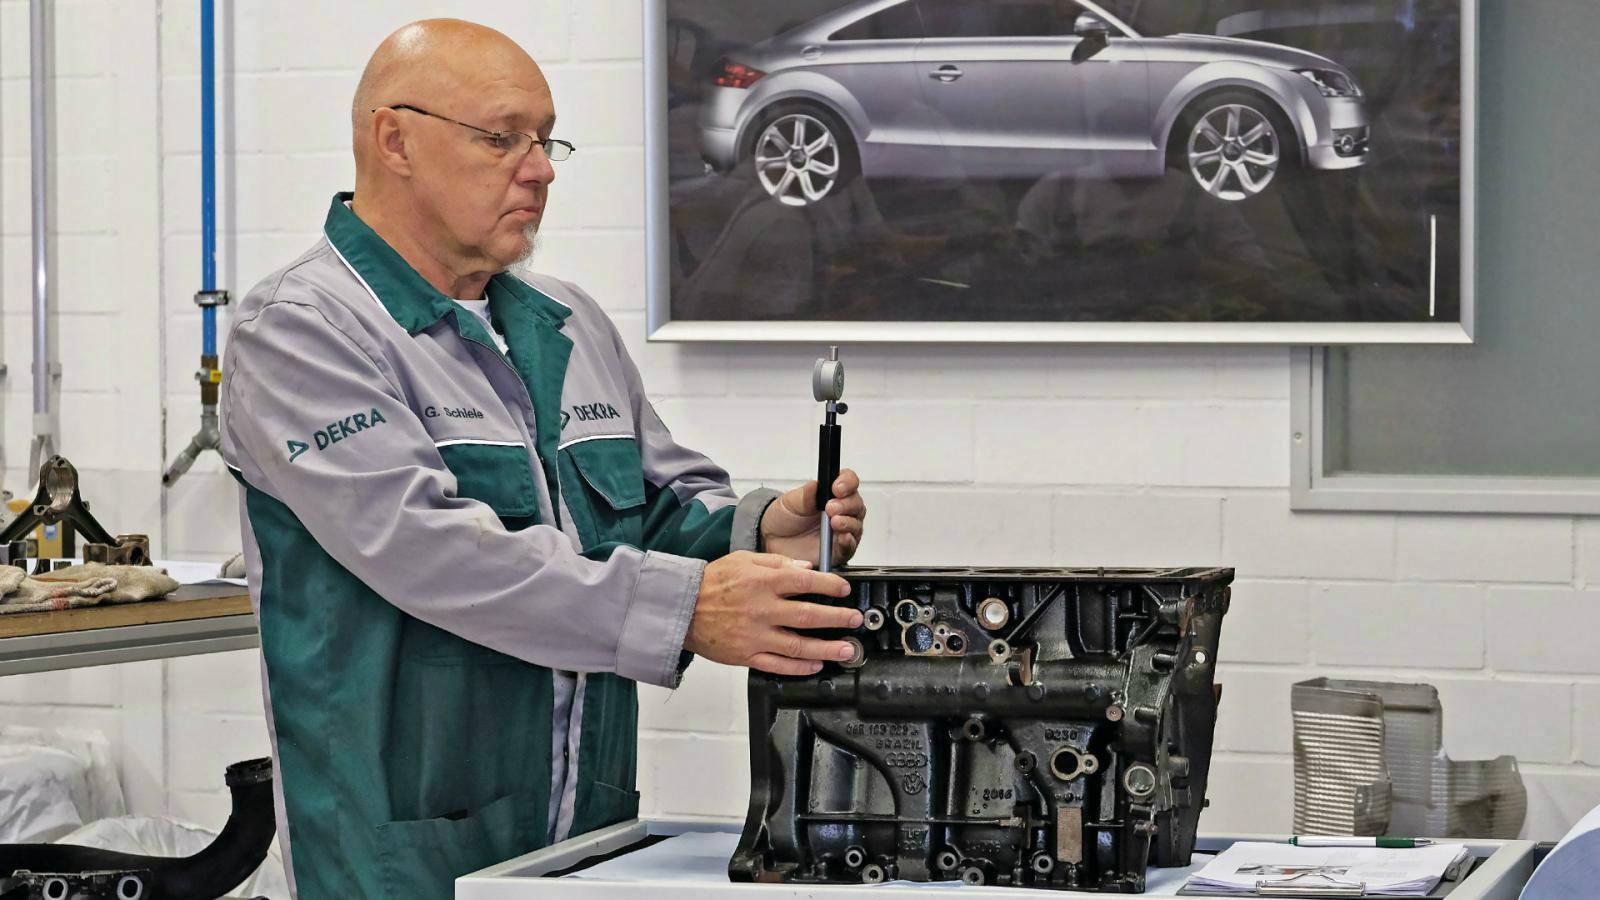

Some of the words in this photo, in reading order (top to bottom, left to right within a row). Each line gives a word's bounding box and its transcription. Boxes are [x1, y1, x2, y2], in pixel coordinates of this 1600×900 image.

[424, 406, 440, 418] G.
[571, 402, 621, 421] DEKRA
[313, 407, 387, 451] DEKRA
[875, 738, 923, 751] BRAZIL
